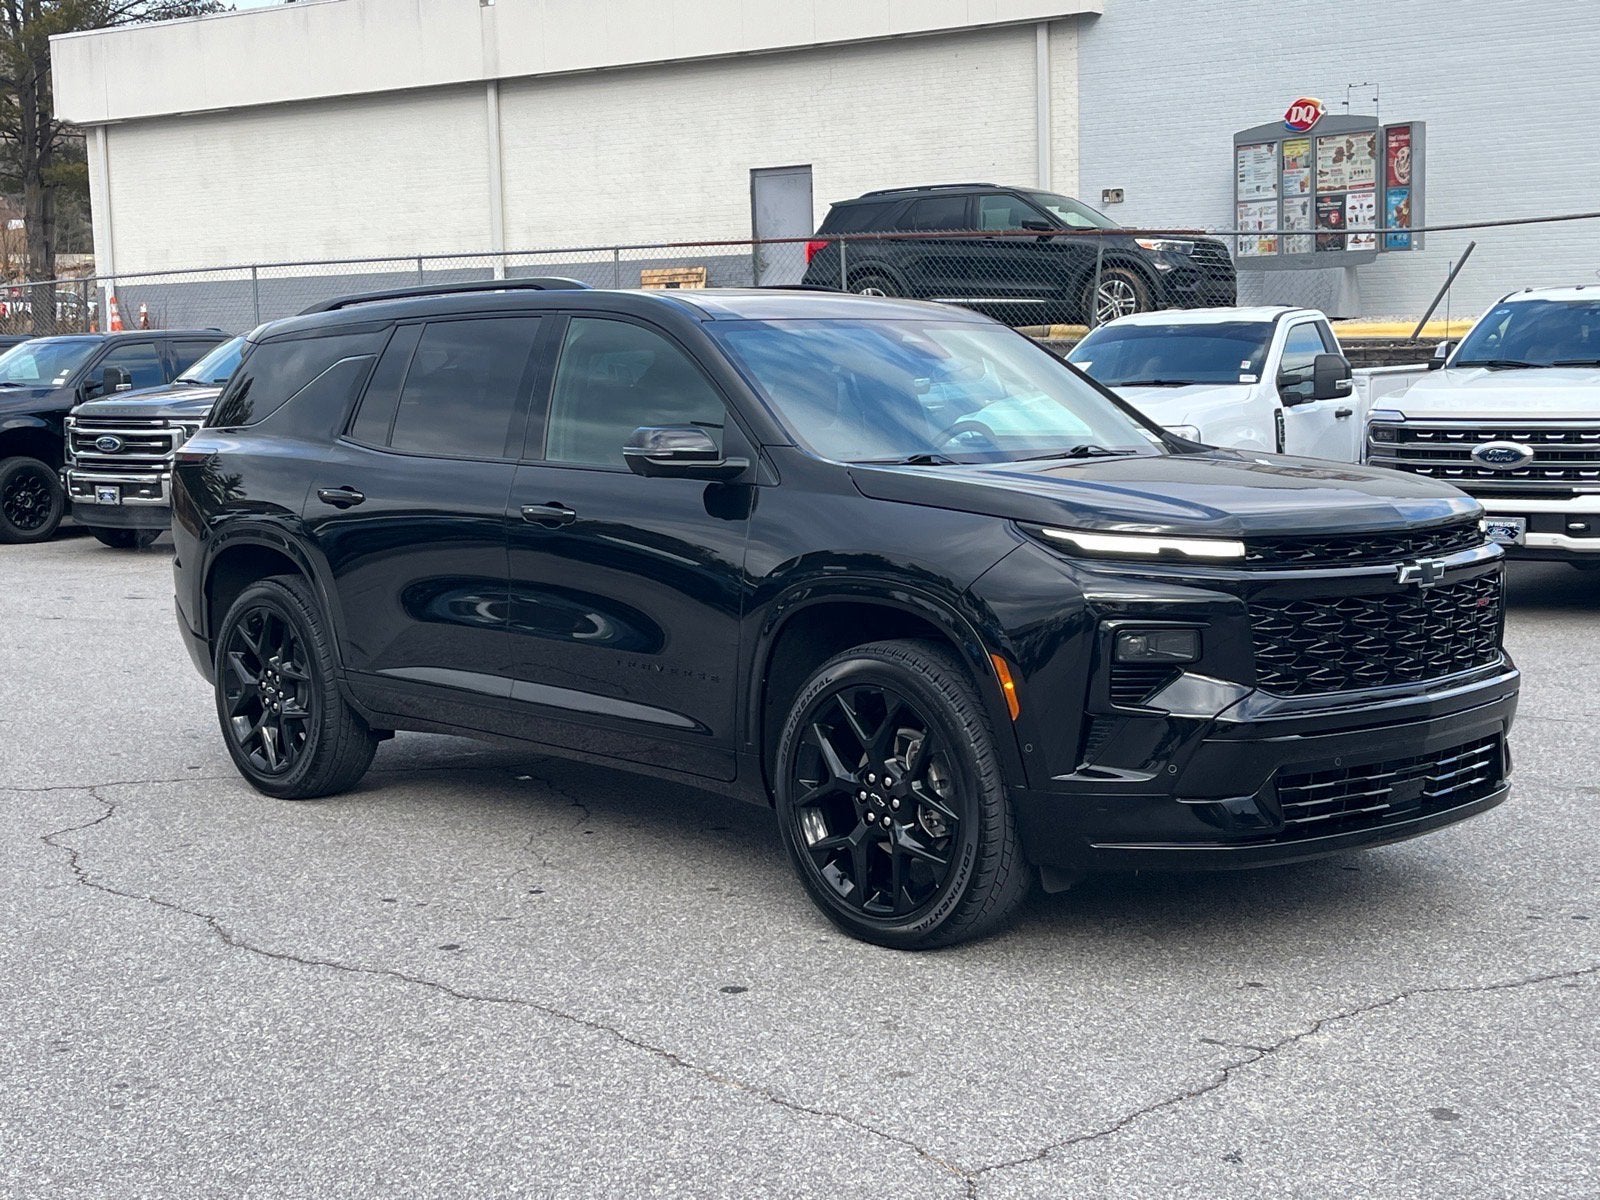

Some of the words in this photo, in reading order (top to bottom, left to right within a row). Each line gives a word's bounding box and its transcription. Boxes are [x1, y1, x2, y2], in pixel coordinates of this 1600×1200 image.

[1290, 105, 1316, 124] DQ
[1486, 448, 1516, 462] Ford
[781, 676, 833, 767] CONTINENTAL
[913, 842, 973, 933] CONTINENTAL
